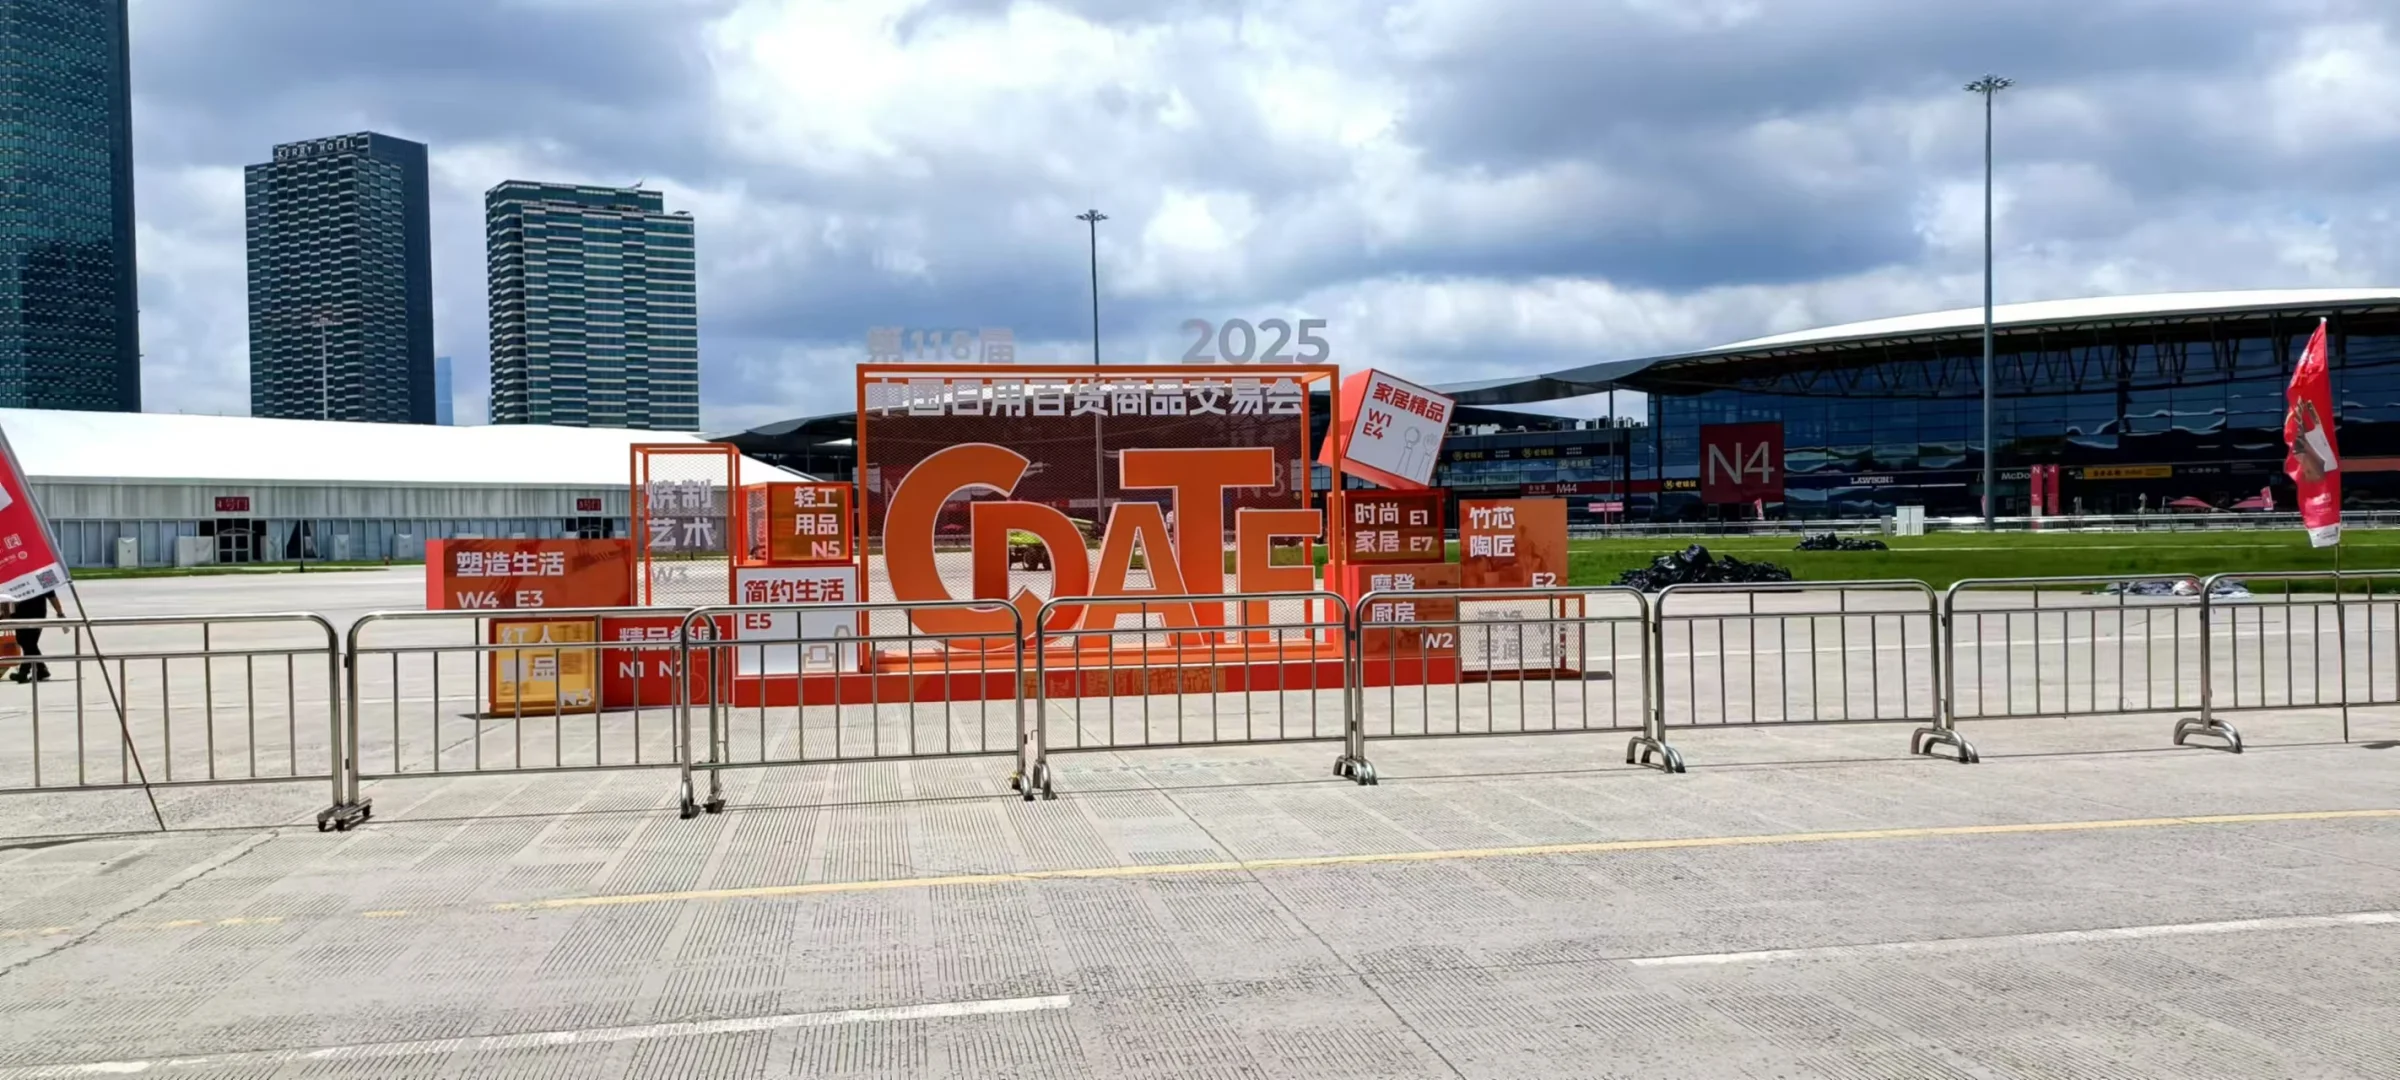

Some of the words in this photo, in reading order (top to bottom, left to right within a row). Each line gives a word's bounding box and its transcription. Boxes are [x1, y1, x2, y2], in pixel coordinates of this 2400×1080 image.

[278, 146, 312, 158] KERRY
[320, 139, 355, 151] HOTEL
[1182, 318, 1330, 363] 2025
[866, 377, 1303, 417] 中国日用百货商品交易会
[1373, 382, 1445, 423] 家居精品
[1368, 408, 1392, 427] W1
[1362, 422, 1383, 440] E4
[1708, 441, 1774, 485] N4
[646, 479, 713, 509] 烧制
[794, 487, 838, 508] 轻工
[1556, 484, 1578, 494] M44
[1355, 502, 1399, 525] 时尚
[1410, 510, 1428, 525] E1
[1469, 506, 1515, 529] 竹芯
[646, 517, 714, 547] 艺术
[795, 514, 839, 536] 用品
[812, 541, 840, 558] N5
[1355, 530, 1400, 553] 家居
[1410, 536, 1433, 552] E7
[1470, 535, 1515, 557] 陶匠
[456, 551, 565, 577] 塑造生活
[650, 566, 688, 583] W3
[744, 578, 845, 604] 简约生活
[1532, 573, 1557, 588] E2
[457, 591, 499, 608] W4
[515, 590, 544, 608] E3
[745, 613, 772, 629] E5
[1372, 602, 1416, 623] 厨房
[1420, 633, 1454, 648] W2
[619, 661, 645, 678] N1
